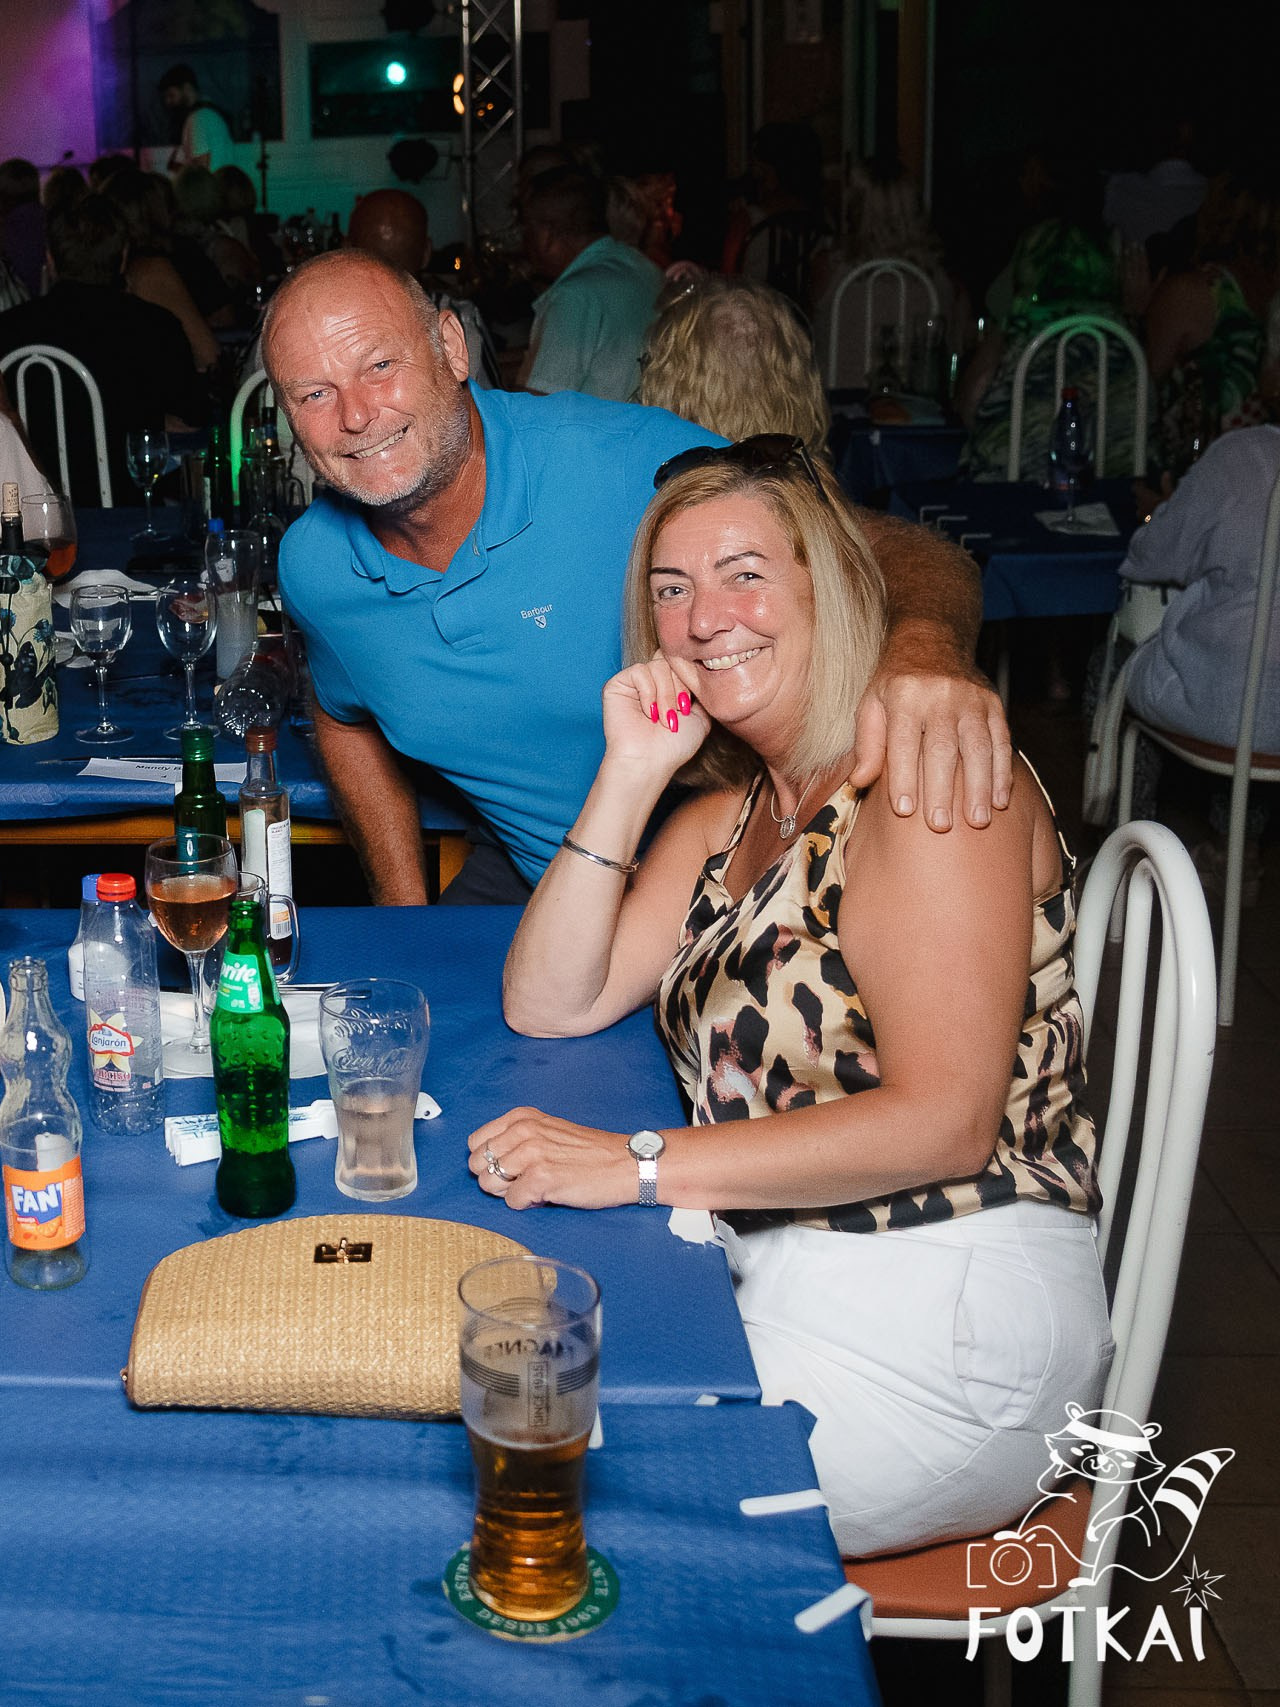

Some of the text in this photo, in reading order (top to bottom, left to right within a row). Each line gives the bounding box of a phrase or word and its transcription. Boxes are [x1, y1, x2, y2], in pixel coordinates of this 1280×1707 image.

[520, 604, 553, 619] Barbour
[91, 1033, 127, 1047] Lanjarón
[476, 1606, 550, 1635] DESDE
